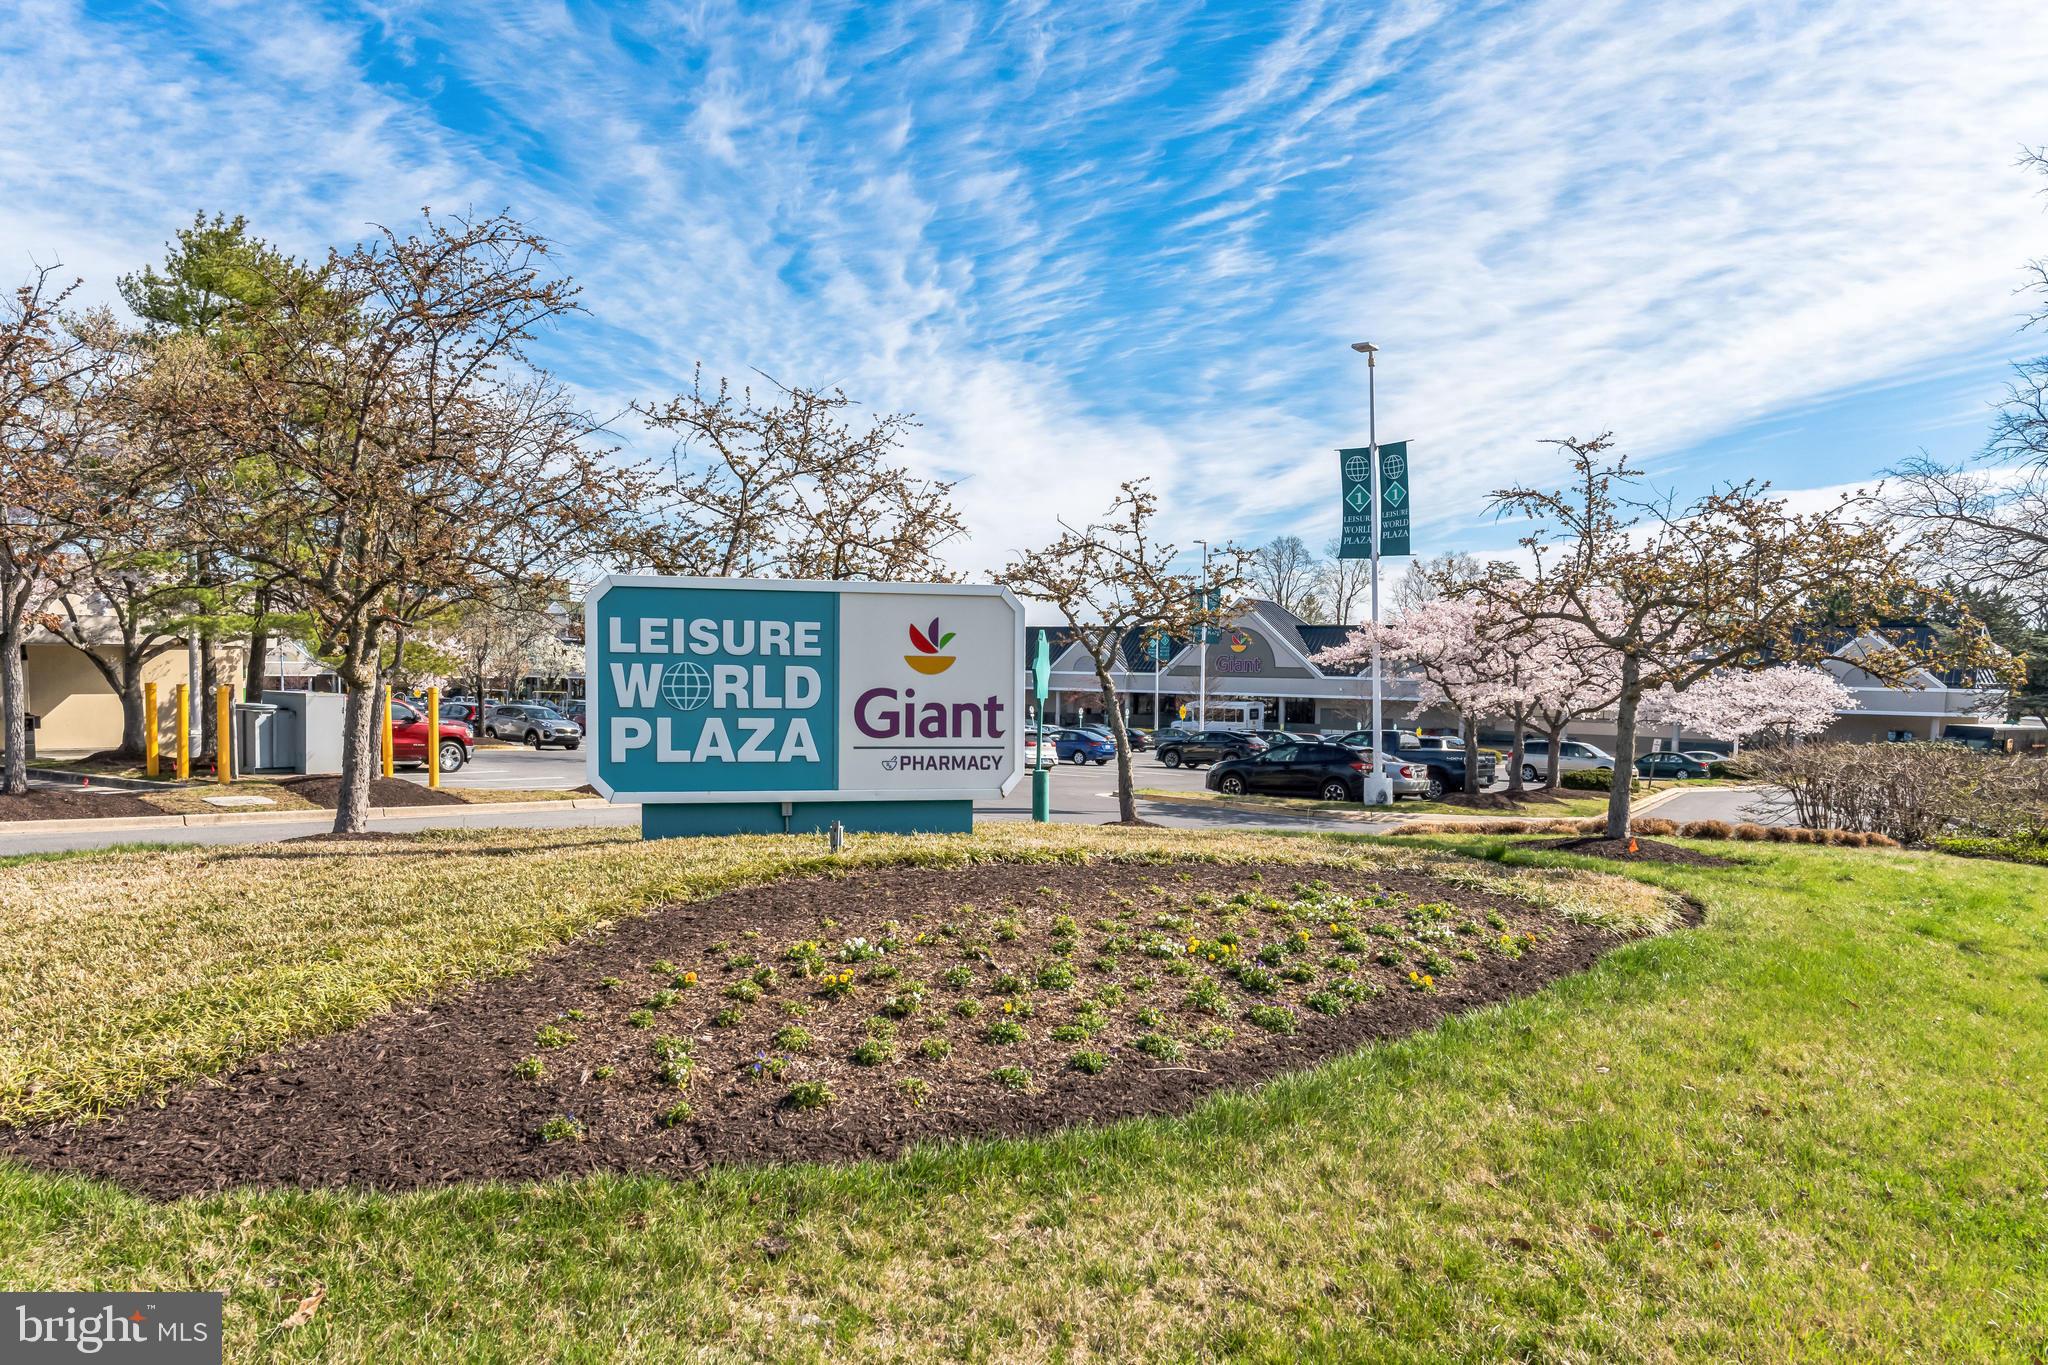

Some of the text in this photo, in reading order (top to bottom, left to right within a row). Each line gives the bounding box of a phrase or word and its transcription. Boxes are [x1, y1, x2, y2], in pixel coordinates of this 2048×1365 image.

[1355, 492, 1364, 505] 1
[1392, 488, 1400, 501] 1
[1344, 515, 1371, 523] LEISUR
[1382, 519, 1409, 529] WORLD
[1344, 536, 1372, 545] PLAZA
[1382, 529, 1408, 539] PLAZA
[609, 616, 822, 657] LEISURE
[1216, 655, 1261, 672] Giant
[610, 662, 822, 711] WORLD
[854, 688, 1006, 738] Giant
[611, 718, 821, 764] PLAZA
[900, 755, 1003, 770] PHARMACY
